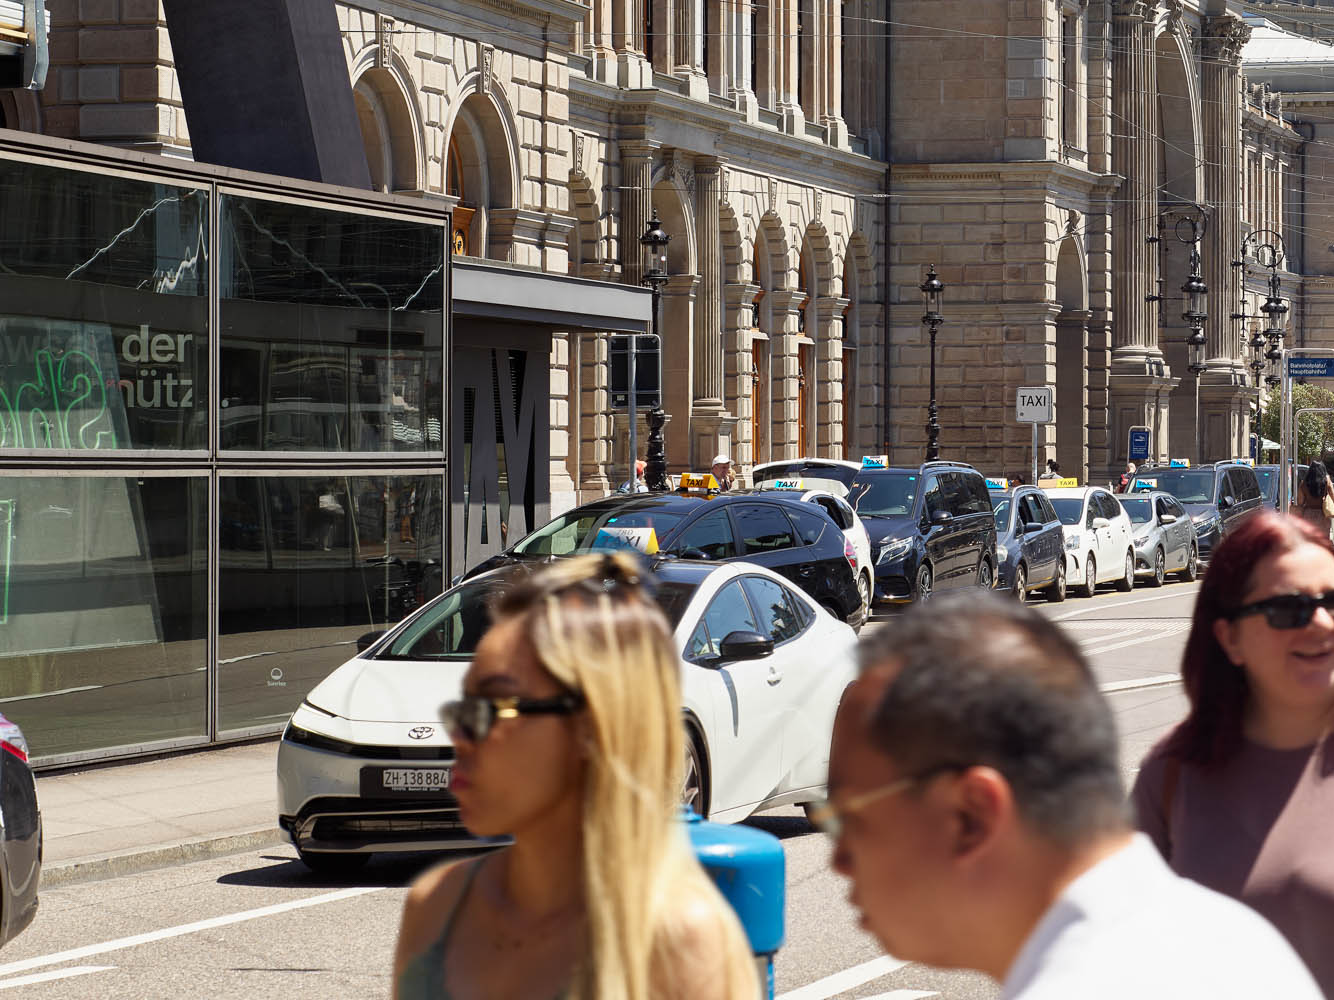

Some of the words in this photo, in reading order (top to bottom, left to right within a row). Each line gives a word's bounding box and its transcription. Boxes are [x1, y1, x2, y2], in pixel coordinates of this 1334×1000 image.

[122, 324, 193, 362] der
[1020, 395, 1046, 407] TAXI
[686, 478, 704, 487] TAXI
[602, 535, 642, 547] TAXI
